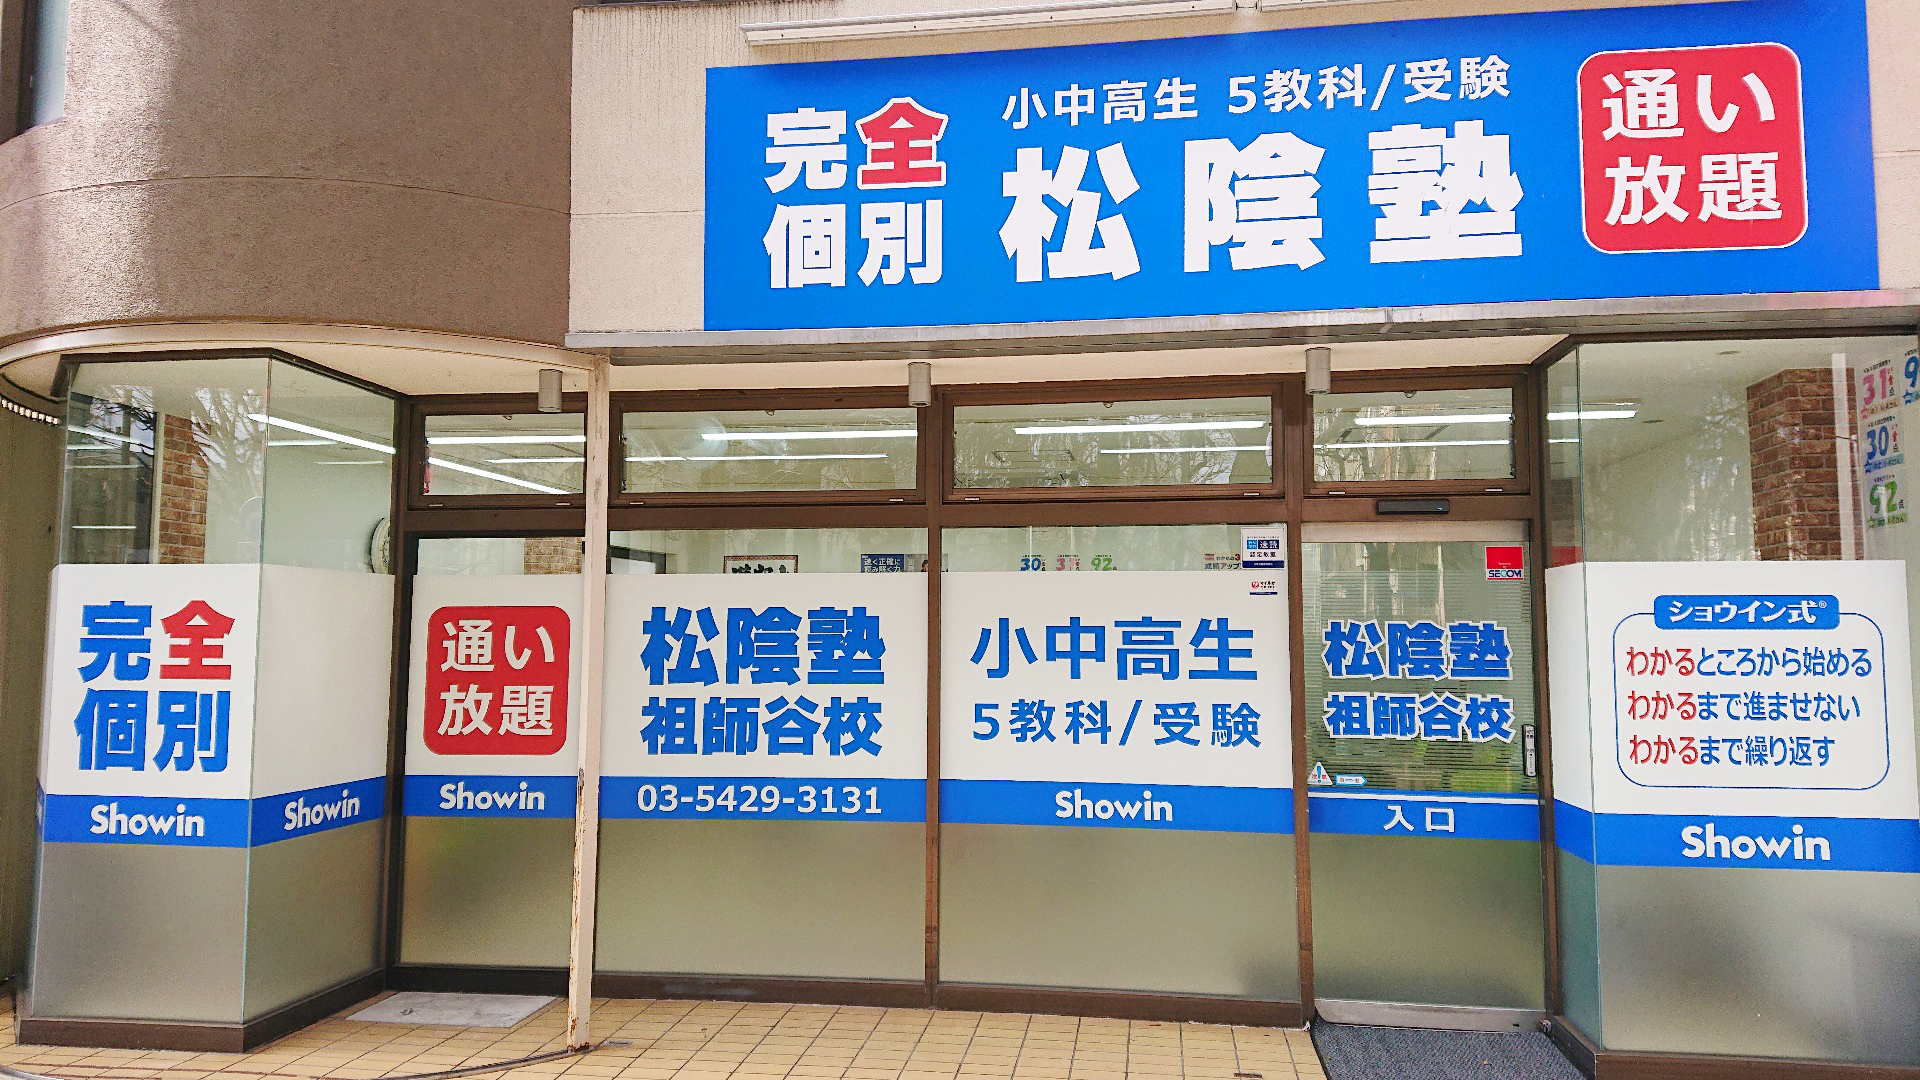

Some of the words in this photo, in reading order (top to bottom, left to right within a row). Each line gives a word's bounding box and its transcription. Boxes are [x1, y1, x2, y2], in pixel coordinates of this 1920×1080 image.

[1002, 77, 1198, 129] 小中高生
[1228, 55, 1511, 114] 5教科/受験
[1602, 68, 1776, 142] 通い
[762, 96, 949, 193] 完全
[998, 120, 1525, 283] 松陰塾
[1604, 152, 1783, 226] 放題
[763, 199, 943, 289] 個別
[1488, 569, 1522, 578] SECOM
[78, 599, 236, 683] 完全
[440, 619, 555, 673] 通い
[640, 606, 887, 687] 松陰塾
[970, 615, 1258, 681] 小中高生
[1322, 620, 1513, 681] 松陰塾
[1626, 646, 1873, 677] わかるところから始める
[73, 687, 231, 773] 個別
[437, 684, 554, 736] 放題
[640, 695, 883, 757] 祖師谷校
[973, 699, 1262, 748] 5教科/受験
[1325, 692, 1515, 743] 祖師谷校
[1627, 690, 1861, 722] わかるまで進ませない
[1629, 735, 1835, 767] わかるまで繰り返す
[90, 803, 205, 838] Showin
[283, 788, 361, 832] Showin
[438, 780, 546, 811] Showin
[636, 783, 882, 815] 03-5429-3131
[1055, 789, 1173, 822] Showin
[1383, 805, 1456, 833] 入口
[1681, 823, 1832, 862] Showin
